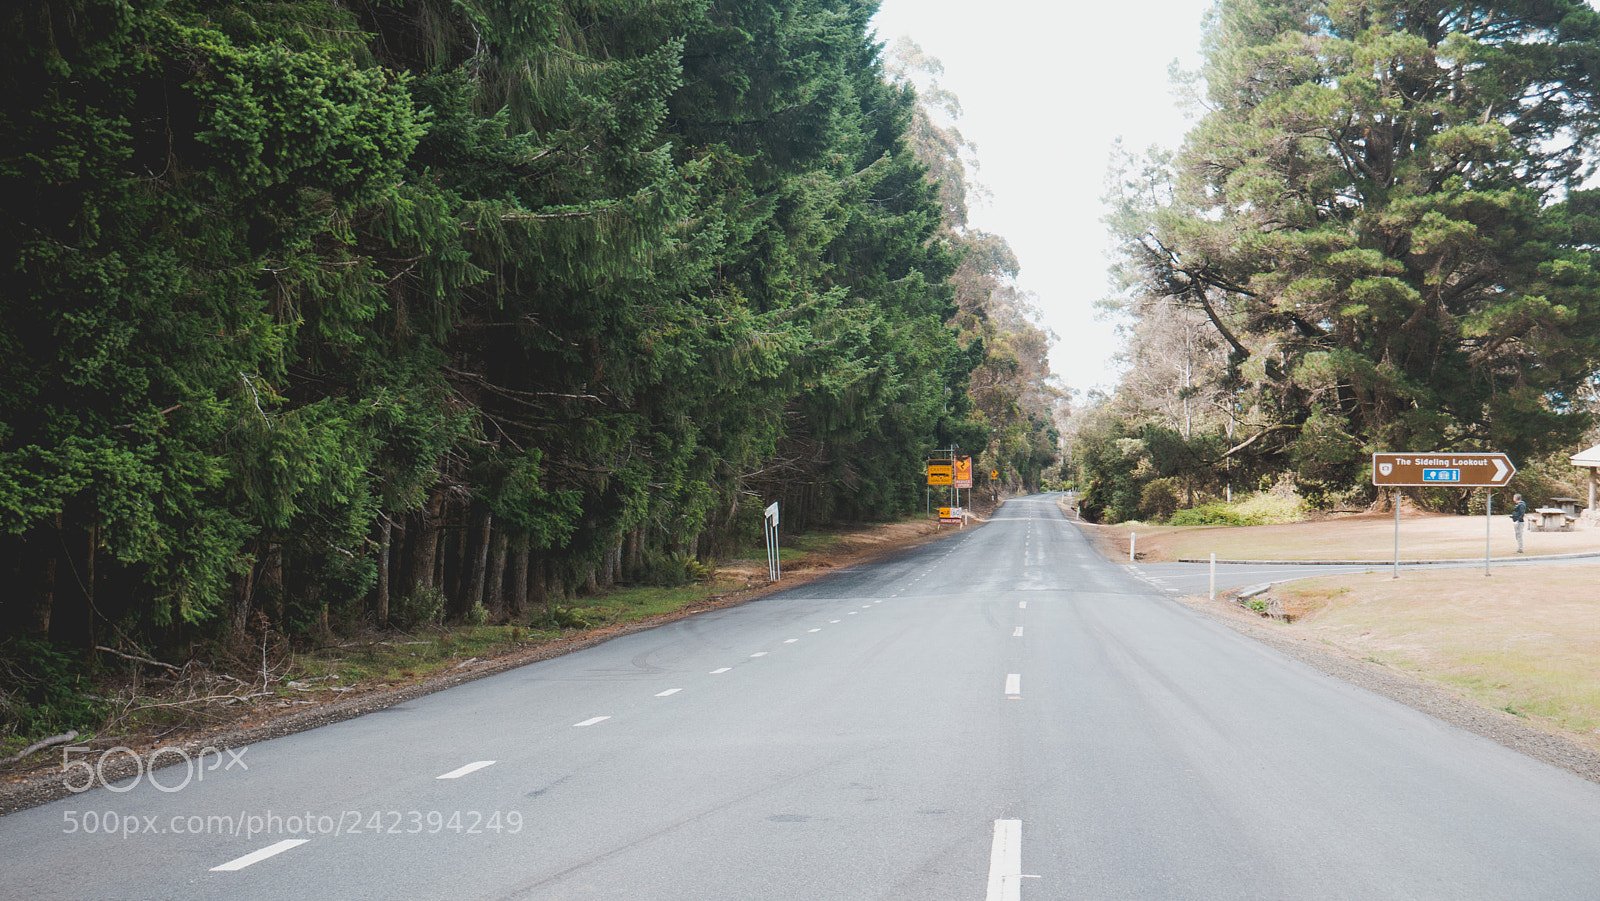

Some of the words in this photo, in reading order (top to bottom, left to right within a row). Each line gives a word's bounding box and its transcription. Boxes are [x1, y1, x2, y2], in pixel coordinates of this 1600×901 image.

[1395, 458, 1411, 466] The
[1414, 458, 1450, 467] Sideling
[1452, 458, 1488, 466] Lookout
